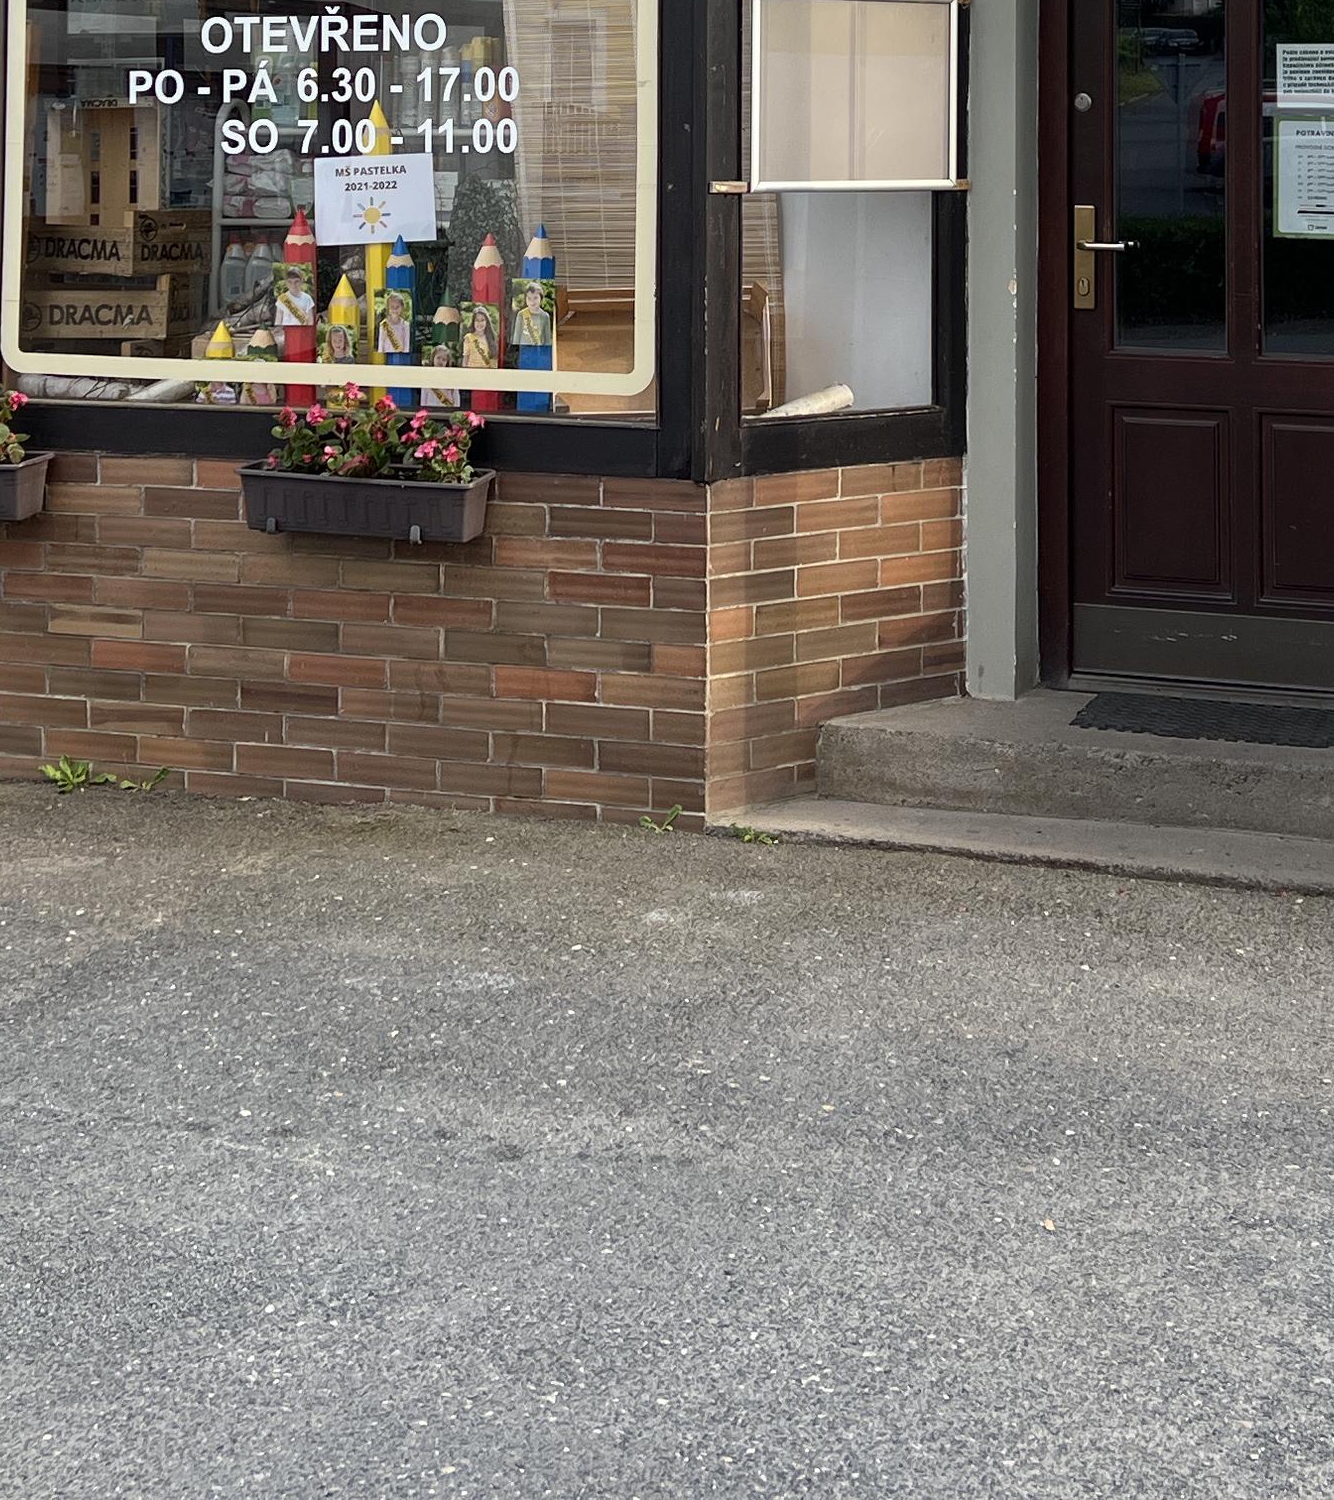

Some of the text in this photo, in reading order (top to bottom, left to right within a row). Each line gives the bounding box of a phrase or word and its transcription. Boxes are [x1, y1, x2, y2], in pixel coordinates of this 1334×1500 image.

[201, 5, 448, 54] OTEVŘENO
[128, 69, 185, 105] PO
[222, 60, 279, 104] PÁ
[296, 66, 377, 103] 6.30
[416, 66, 520, 103] 17.00
[220, 119, 279, 155] SO
[297, 118, 377, 155] 7.00
[416, 118, 519, 154] 11.00
[335, 165, 407, 177] MŠ PASTELKA
[344, 181, 398, 191] 2021-2022
[44, 237, 121, 262] DRACMA
[140, 243, 204, 262] DRACMA
[49, 304, 154, 326] DRACMA
